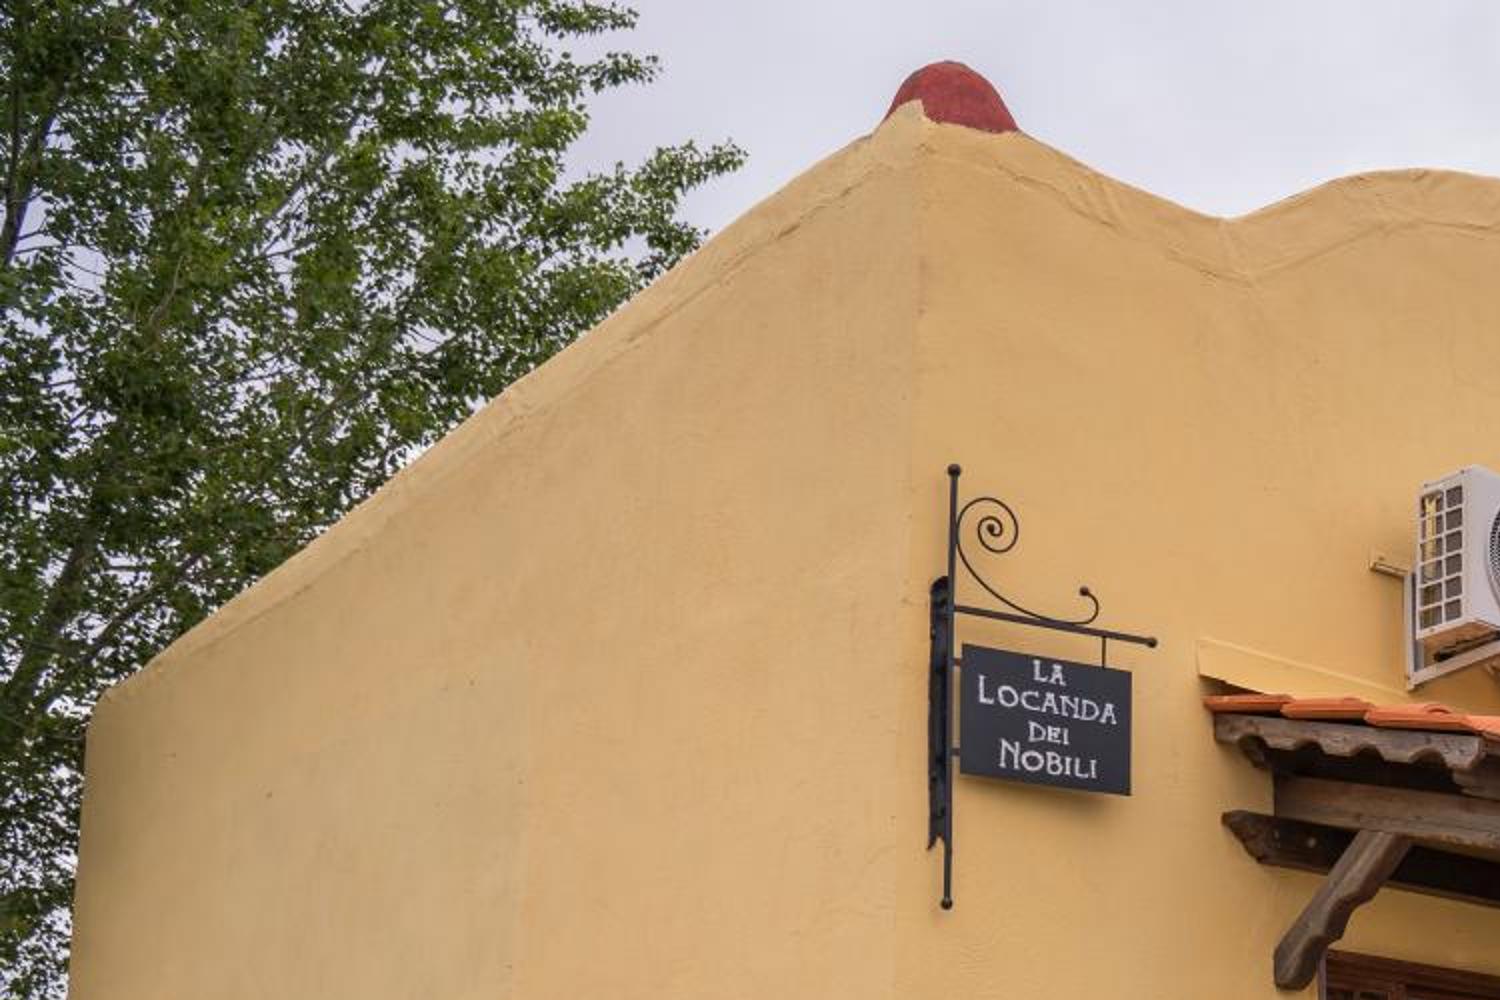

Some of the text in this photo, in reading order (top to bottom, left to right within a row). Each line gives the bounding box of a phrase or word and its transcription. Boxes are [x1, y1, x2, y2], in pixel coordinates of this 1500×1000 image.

[1033, 659, 1067, 687] LA
[978, 674, 1118, 725] LOCANDA
[1028, 720, 1070, 745] DEI
[998, 738, 1098, 779] NOBILI
